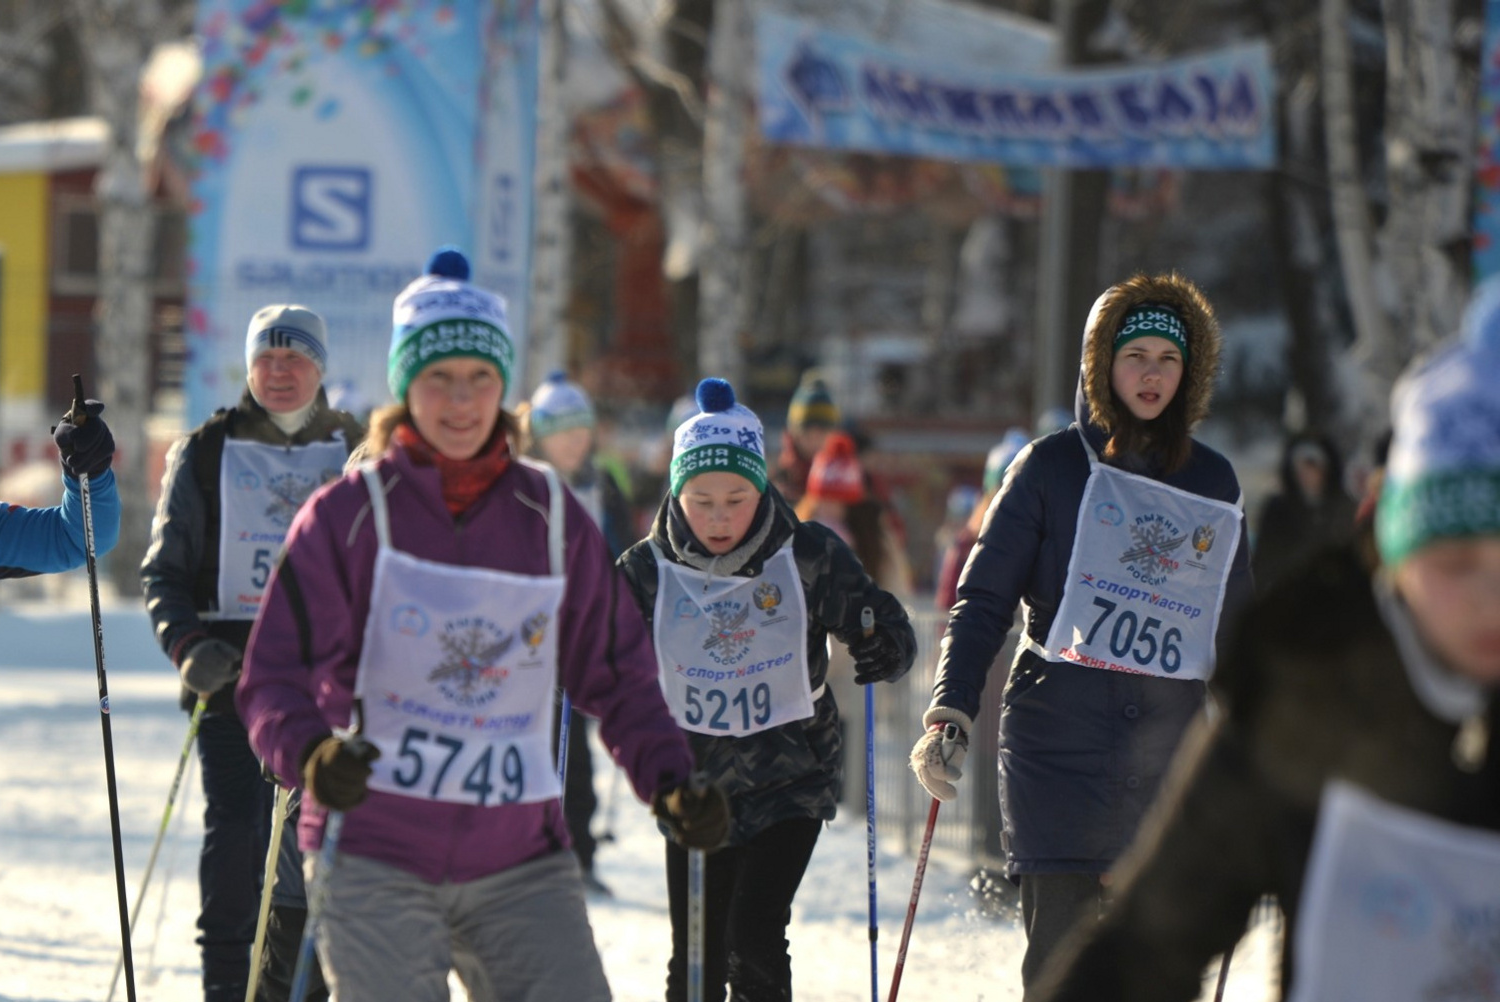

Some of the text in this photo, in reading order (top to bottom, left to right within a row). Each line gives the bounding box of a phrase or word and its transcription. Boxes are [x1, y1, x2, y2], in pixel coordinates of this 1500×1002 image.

[1115, 320, 1188, 348] ОССИИ
[1134, 513, 1180, 537] ЛЫЖНЯ
[1126, 564, 1168, 587] РОССИИ
[703, 600, 742, 614] ЫЖНЯ
[1096, 579, 1202, 619] спортмастер
[1083, 595, 1183, 675] 7056
[686, 652, 794, 682] спортмастер
[708, 646, 751, 666] РОССИИ
[684, 682, 772, 731] 5219
[391, 727, 526, 806] 5749
